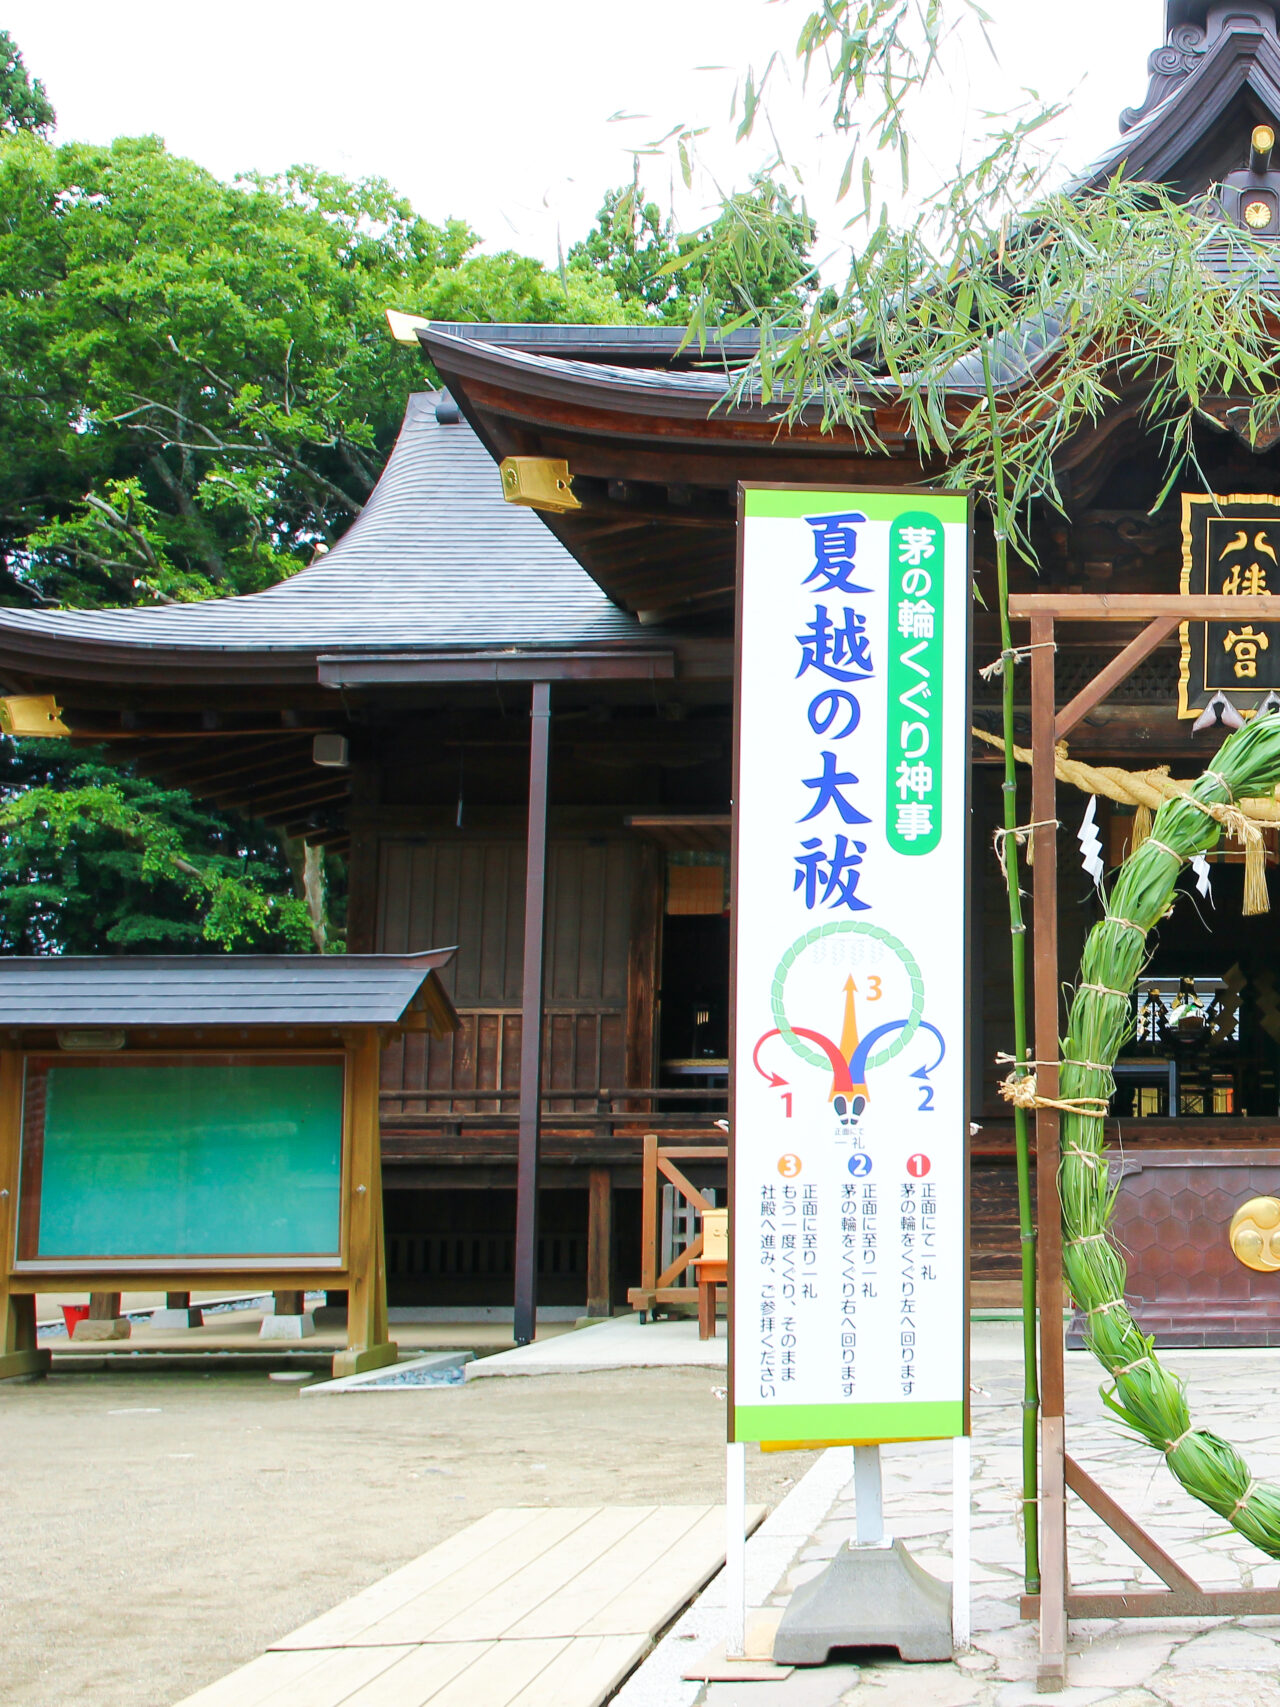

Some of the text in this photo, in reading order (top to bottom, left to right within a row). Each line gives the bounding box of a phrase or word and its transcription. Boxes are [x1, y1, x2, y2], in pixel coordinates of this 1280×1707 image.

[793, 512, 875, 912] 夏越の大祓
[895, 526, 935, 842] 茅の輪くぐり神事
[866, 975, 884, 1001] 3
[780, 1085, 936, 1118] 1 2
[834, 1127, 865, 1136] 正面にて
[834, 1136, 866, 1150] 一礼
[780, 1185, 797, 1383] もう一度くぐり、そのまま
[801, 1184, 819, 1300] 正面に至り一礼
[840, 1183, 857, 1397] 茅の輪をくぐり右へ回ります
[861, 1183, 879, 1299] 正面に至り一礼
[900, 1183, 916, 1396] 茅の輪をくぐり左へ回ります
[920, 1183, 938, 1281] 正面にて一礼
[759, 1184, 776, 1399] 社殿へ進み、ご参拝ください
